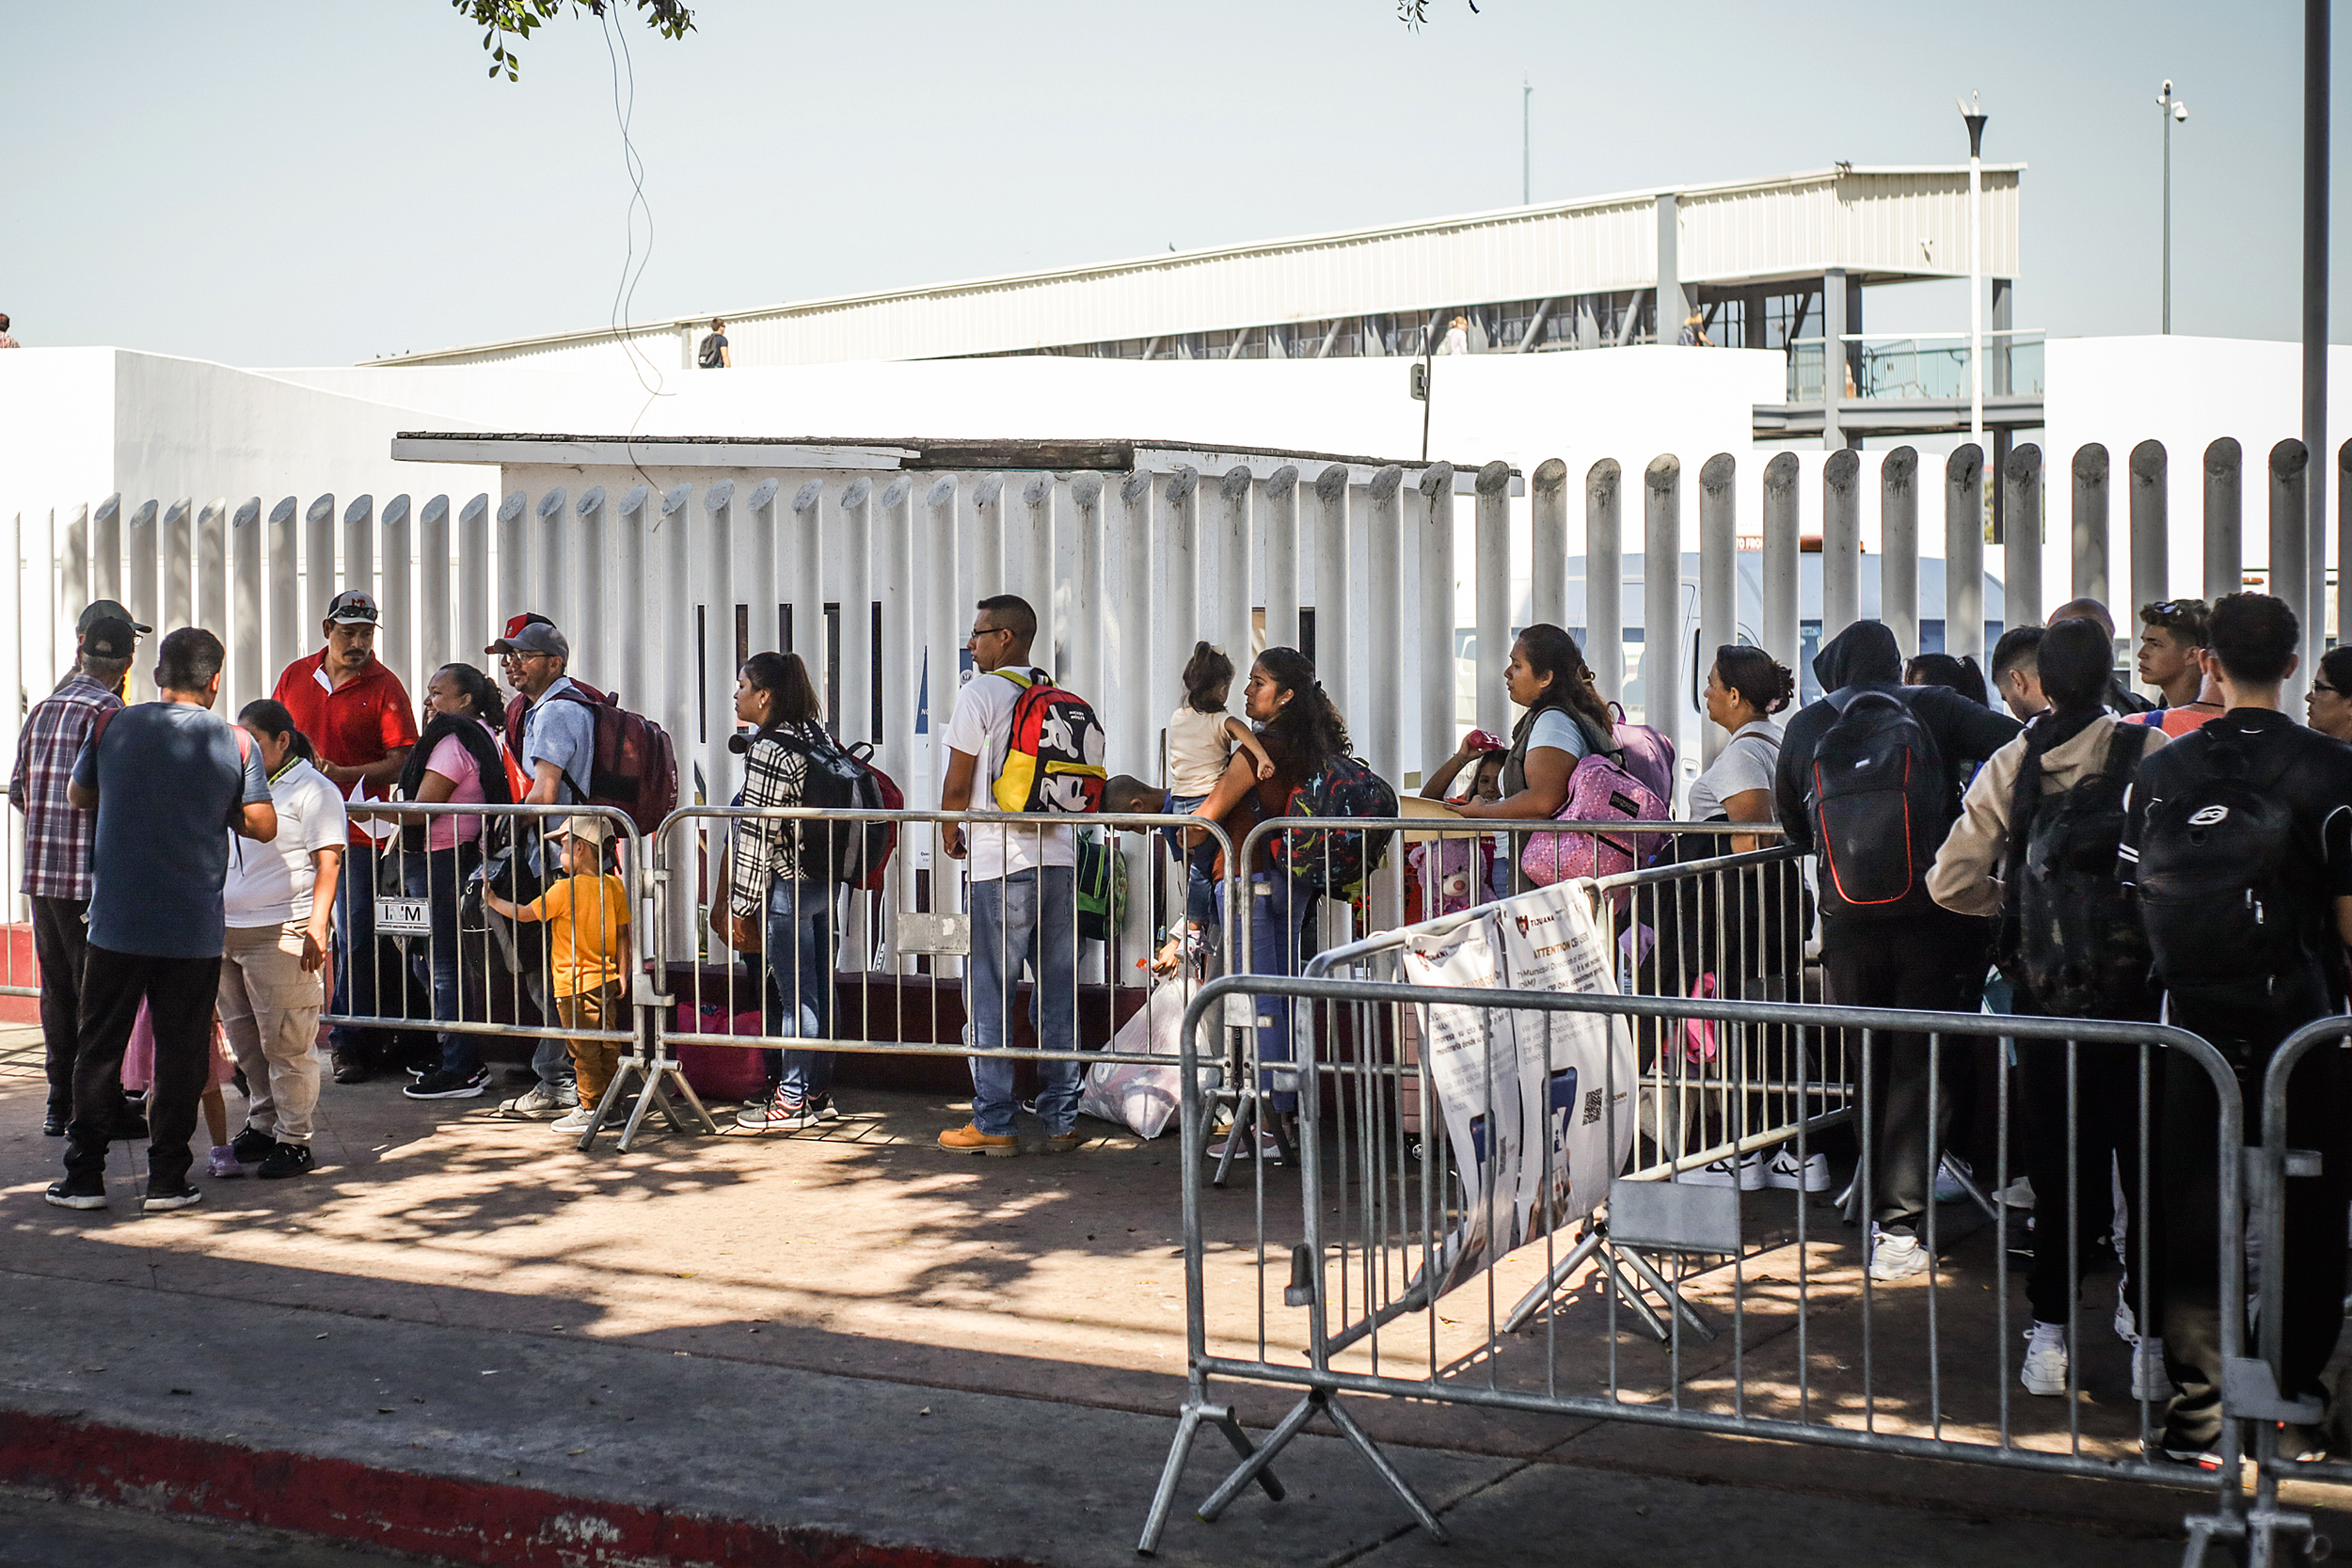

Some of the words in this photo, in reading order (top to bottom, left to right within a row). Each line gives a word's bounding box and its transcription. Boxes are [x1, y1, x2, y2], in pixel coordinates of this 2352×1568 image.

[1746, 537, 1763, 549] FRO
[1530, 914, 1555, 927] TIJUANA
[1533, 940, 1571, 960] ATTENTION
